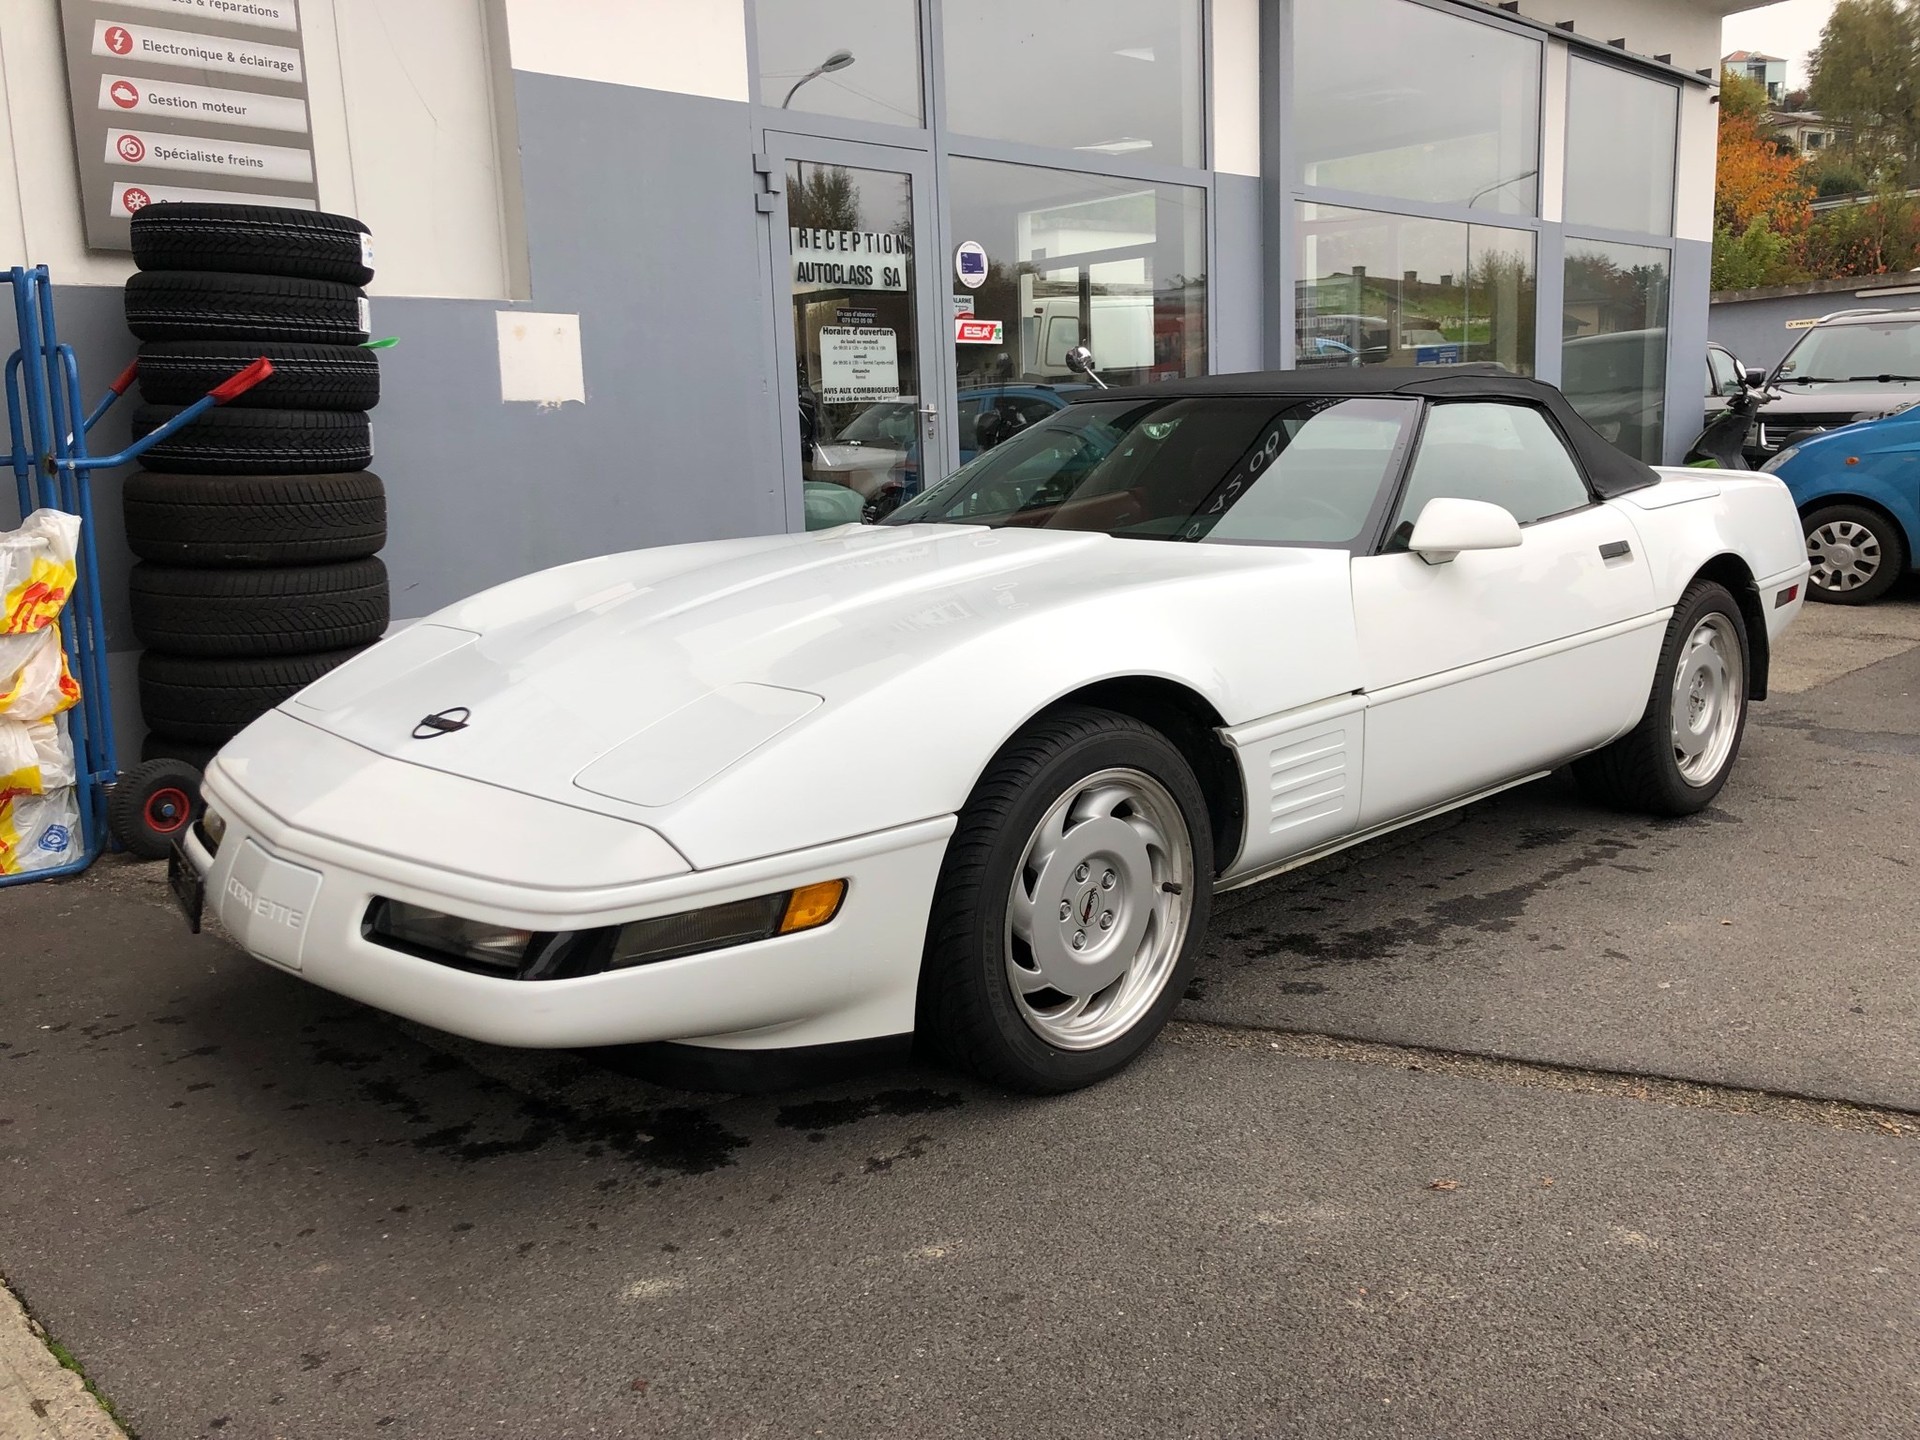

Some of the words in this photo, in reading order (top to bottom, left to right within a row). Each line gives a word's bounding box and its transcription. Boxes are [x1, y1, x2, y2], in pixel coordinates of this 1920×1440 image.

[142, 39, 223, 61] Electronique
[227, 52, 236, 63] &
[240, 53, 295, 73] éclairage
[148, 93, 198, 109] Gestion
[202, 102, 247, 115] moteur
[154, 146, 225, 164] Spécialiste
[228, 154, 264, 168] freins
[798, 227, 906, 254] RECEPTION
[797, 262, 873, 286] AUTOCLASS
[883, 267, 901, 287] SA
[822, 327, 851, 336] Horaire
[852, 327, 894, 337] d'ouverture
[228, 877, 304, 930] CORVETTE
